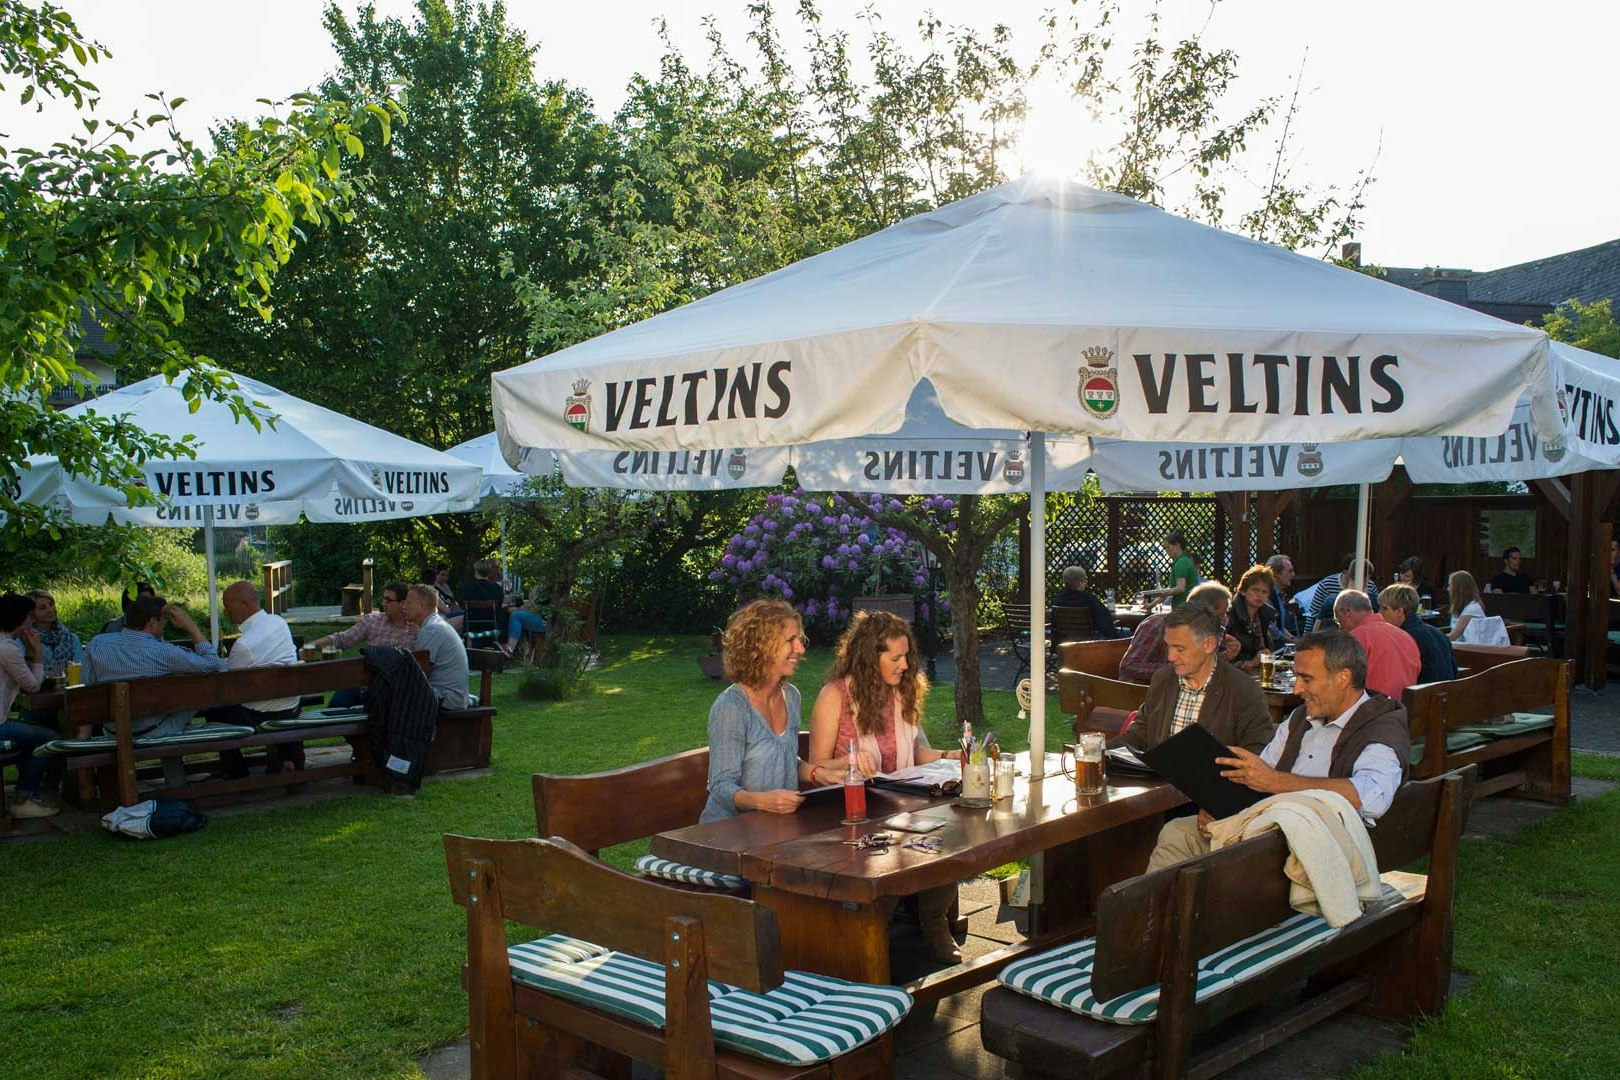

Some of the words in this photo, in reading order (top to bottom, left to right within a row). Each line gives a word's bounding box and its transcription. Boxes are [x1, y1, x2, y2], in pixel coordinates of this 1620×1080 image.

[605, 360, 792, 432] VELTINS
[1132, 352, 1405, 416] VELTINS
[155, 470, 276, 496] VELTINS
[384, 471, 450, 494] VELTINS
